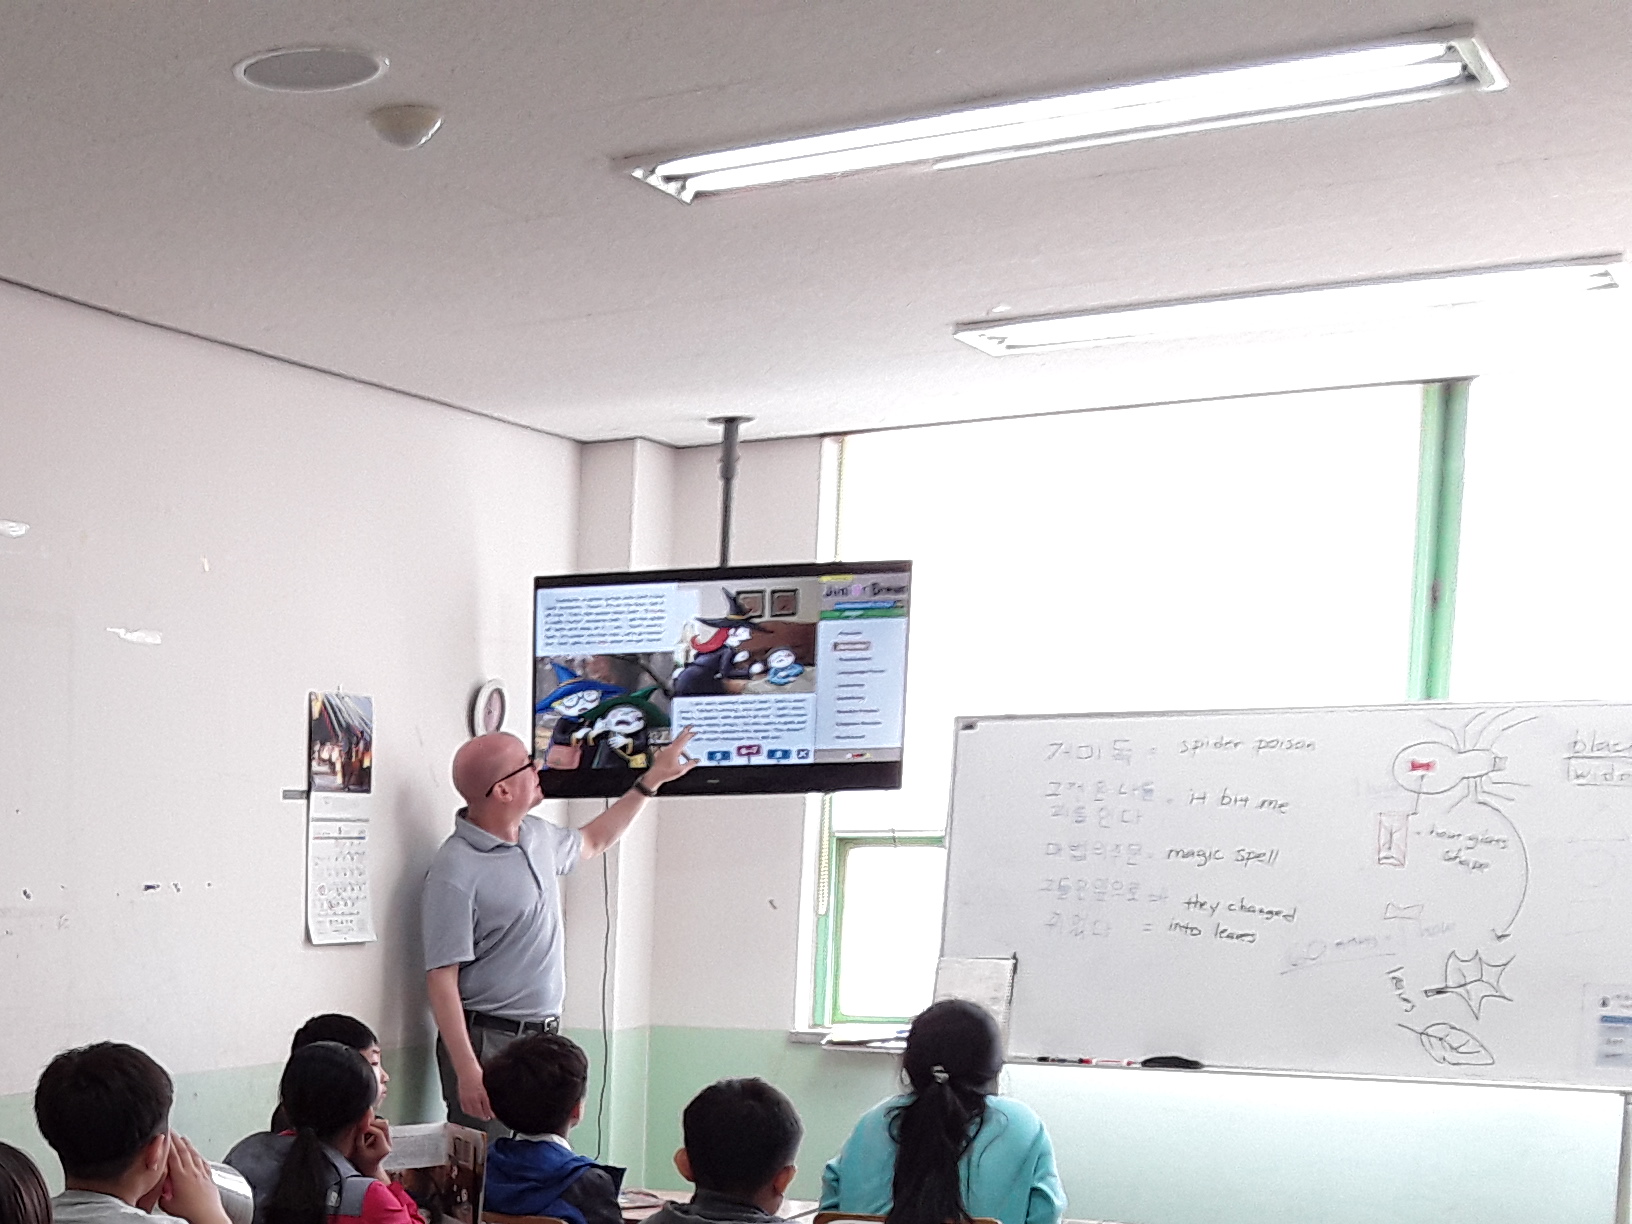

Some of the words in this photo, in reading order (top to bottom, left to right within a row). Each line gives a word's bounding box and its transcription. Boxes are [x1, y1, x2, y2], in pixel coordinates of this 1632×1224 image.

[1180, 736, 1242, 757] spider
[1254, 739, 1315, 758] poison
[1167, 848, 1224, 867] magic
[1234, 849, 1279, 868] spell
